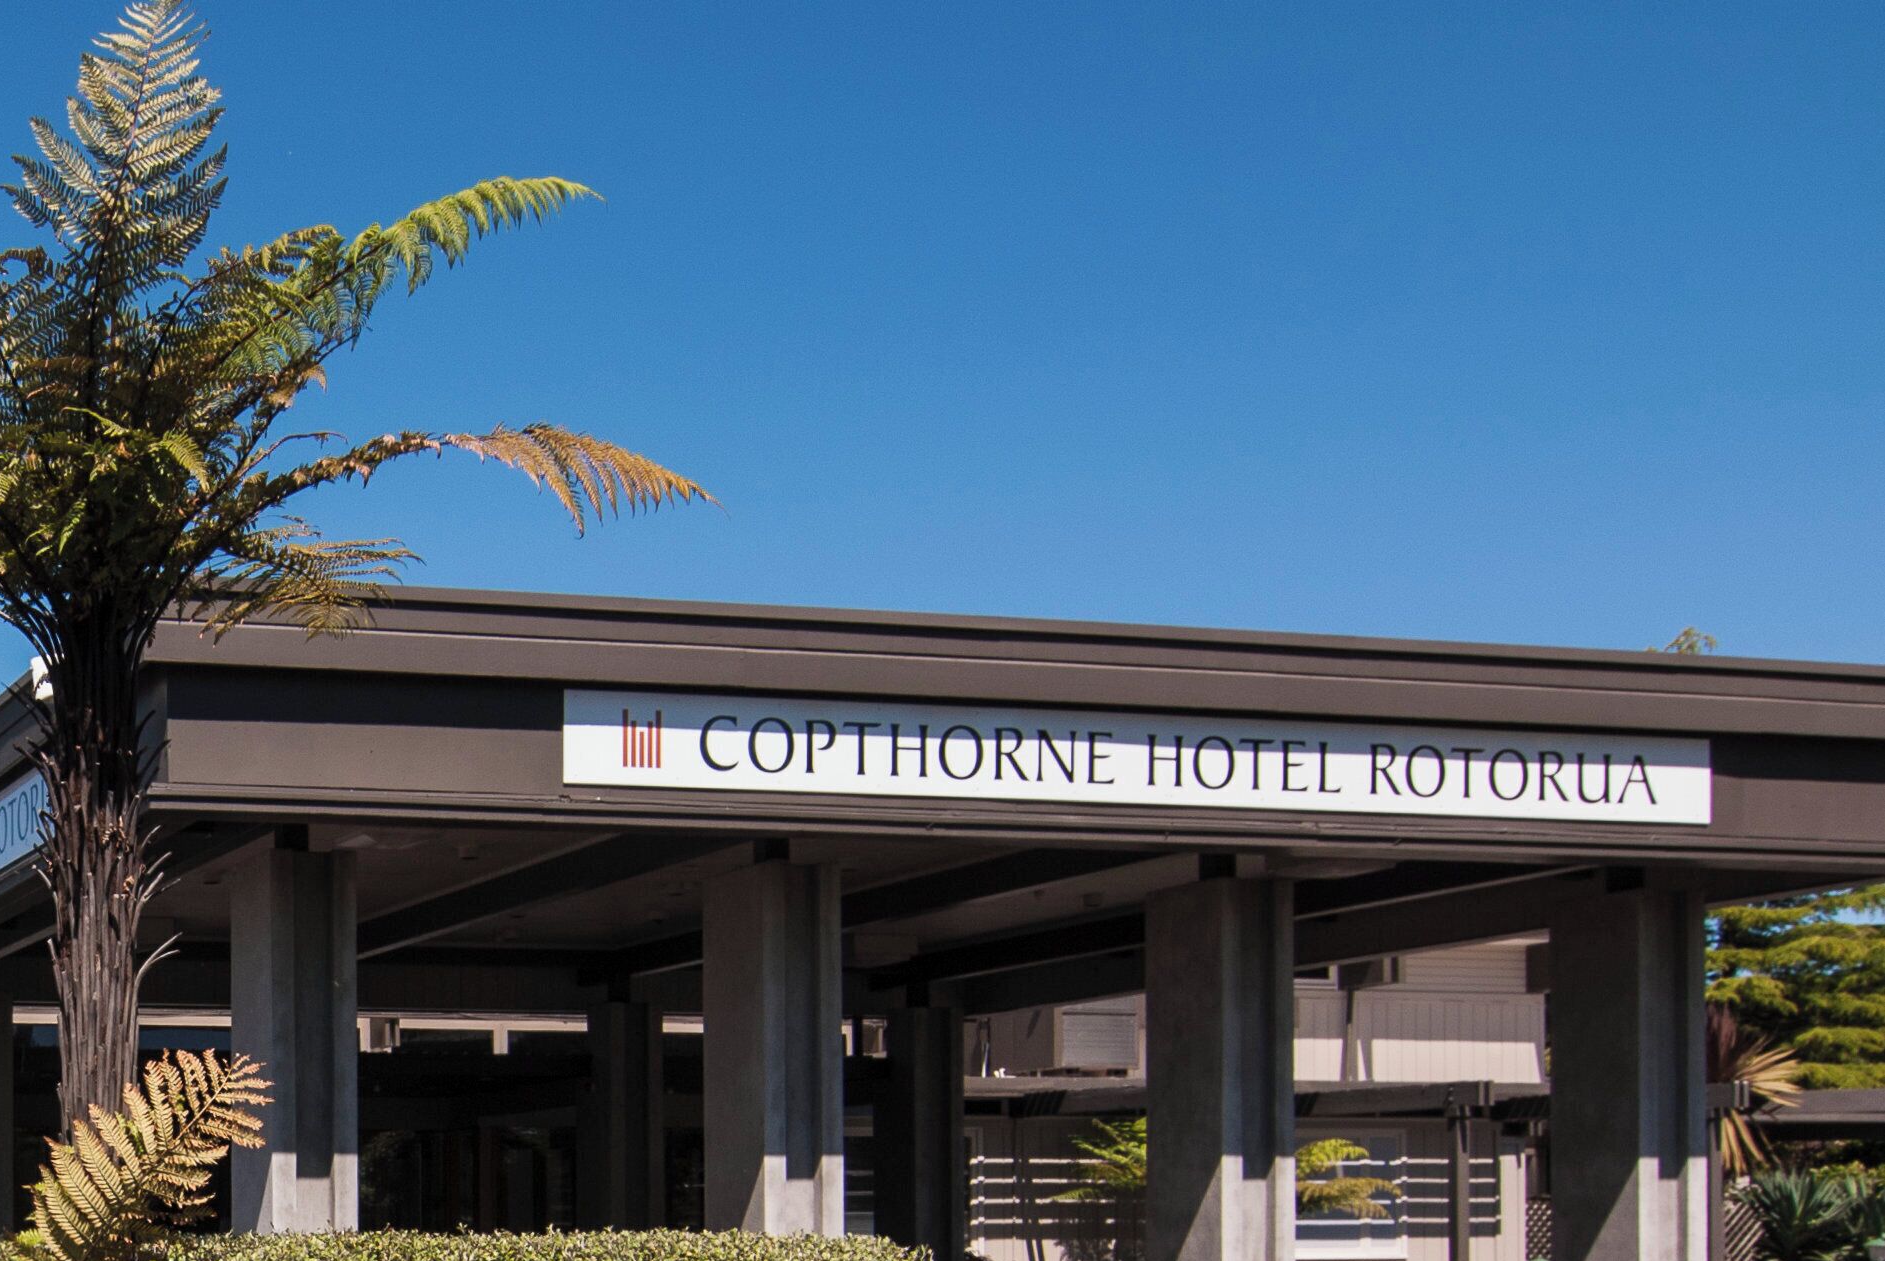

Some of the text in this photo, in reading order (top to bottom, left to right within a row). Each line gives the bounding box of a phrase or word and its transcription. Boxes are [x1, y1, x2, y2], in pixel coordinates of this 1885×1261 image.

[699, 714, 1659, 805] COPTHORNE HOTEL ROTORUA
